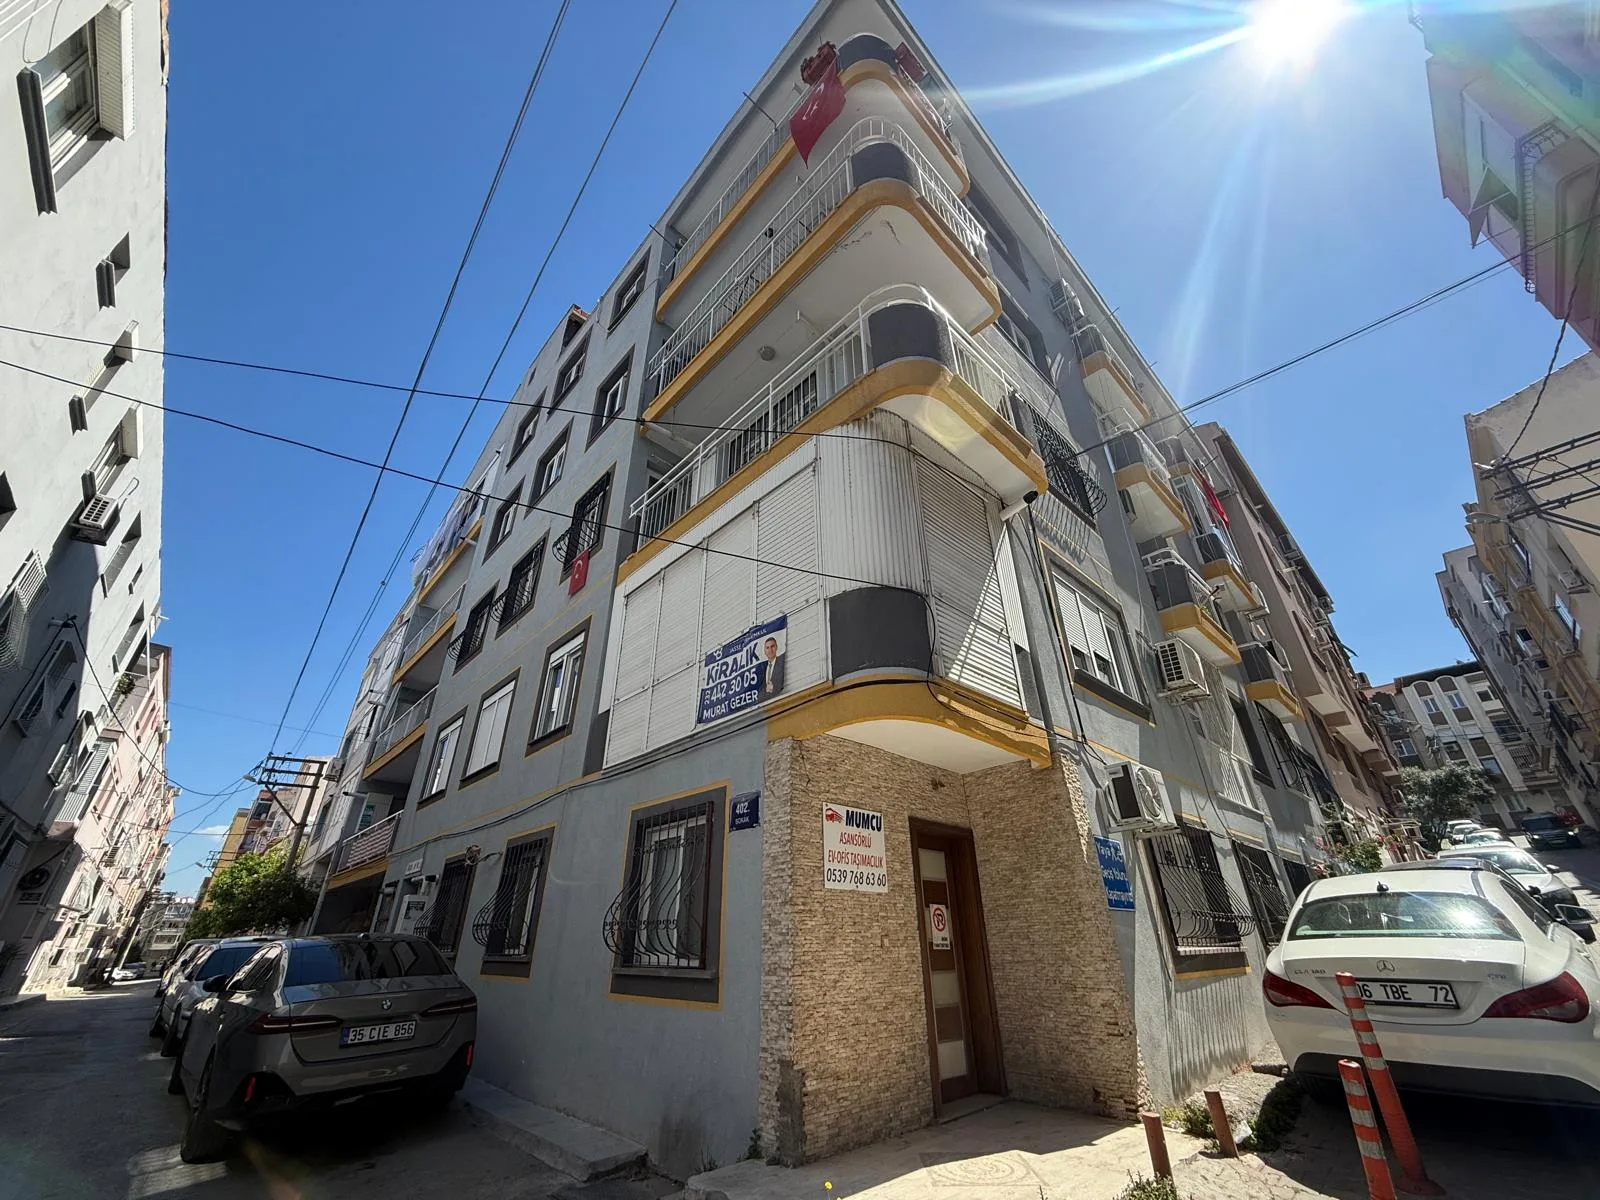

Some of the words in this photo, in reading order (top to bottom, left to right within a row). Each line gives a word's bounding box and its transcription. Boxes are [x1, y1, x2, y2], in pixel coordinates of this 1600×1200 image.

[729, 677, 742, 694] 30
[744, 668, 758, 687] 05
[703, 701, 729, 720] MURAT
[731, 690, 758, 708] GEZER
[845, 810, 882, 832] MUMCU
[840, 832, 872, 848] ASANSÖRLÜ
[826, 868, 848, 883] 0539
[849, 870, 864, 885] 768
[865, 872, 875, 886] 63
[877, 873, 887, 887] 60
[1380, 984, 1412, 1000] TBE
[1428, 986, 1454, 1003] 72
[350, 1029, 364, 1041] 35
[369, 1026, 389, 1040] CIE
[394, 1023, 413, 1036] 856
